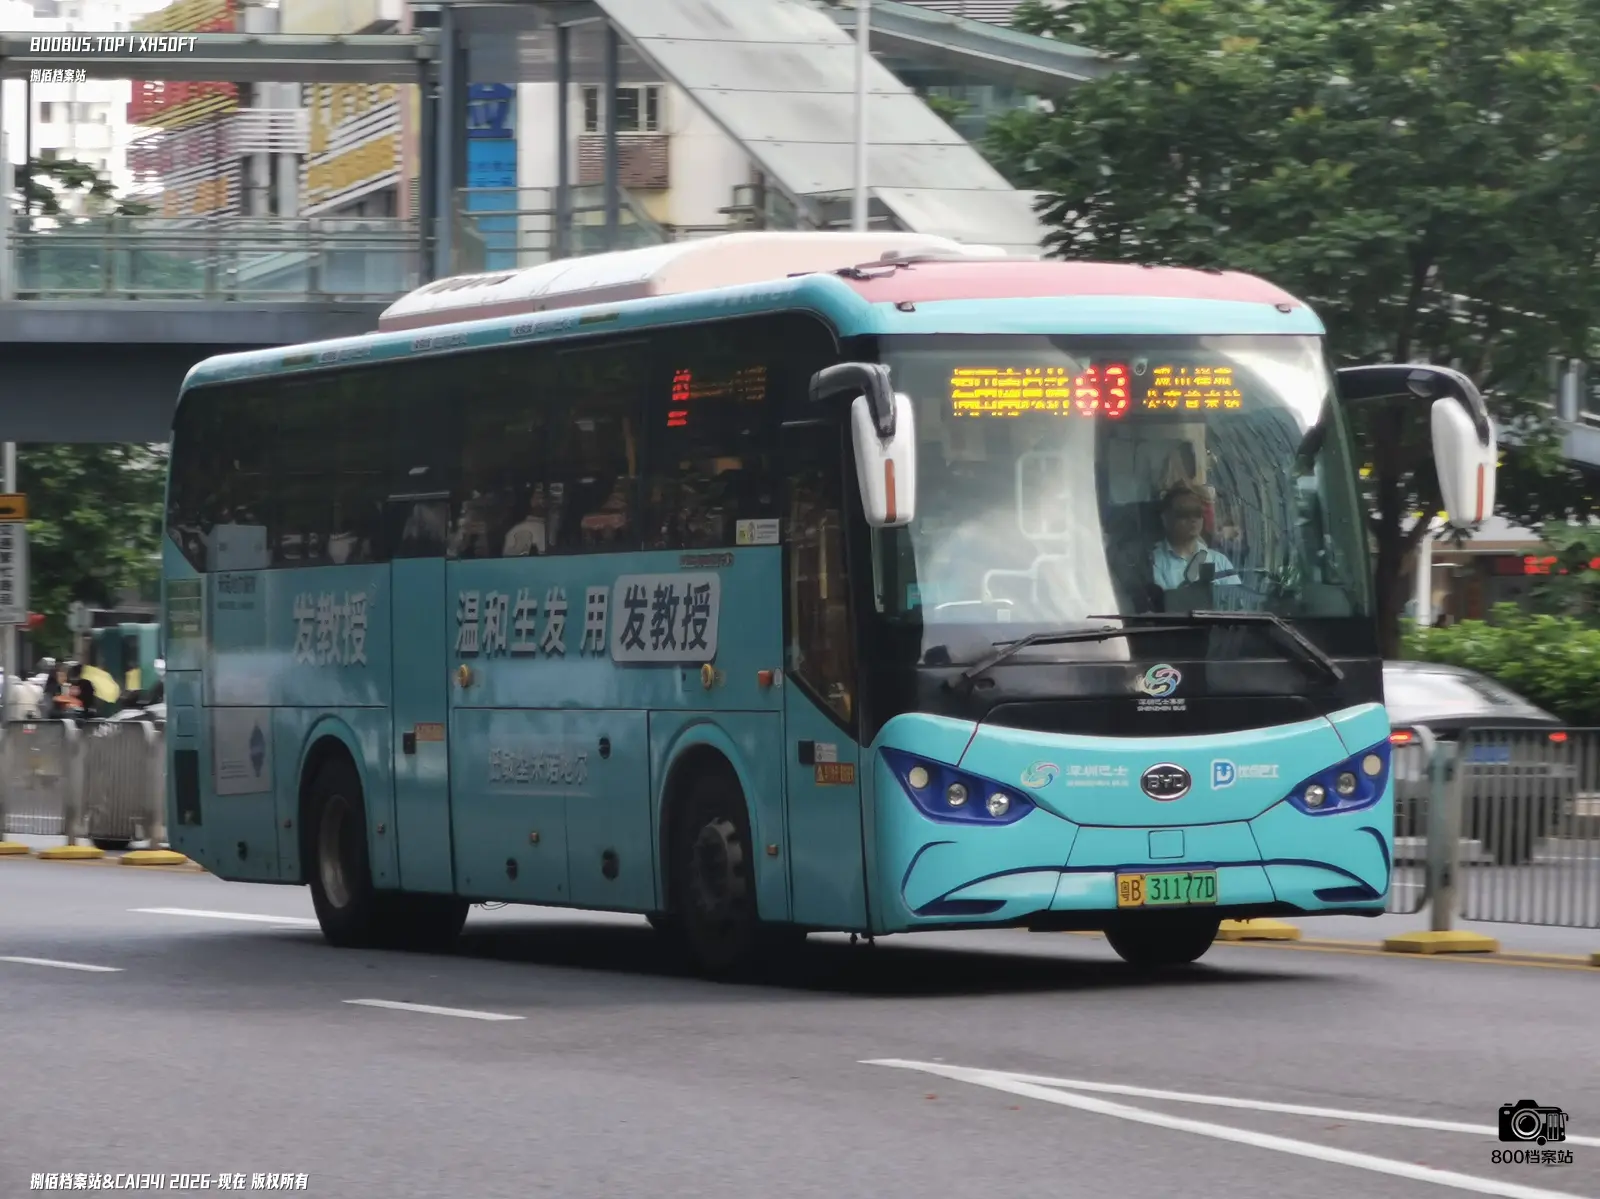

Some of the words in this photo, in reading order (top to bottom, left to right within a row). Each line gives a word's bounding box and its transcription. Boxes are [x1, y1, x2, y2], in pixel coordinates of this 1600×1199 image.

[1073, 366, 1129, 418] 63
[292, 591, 368, 667] 发教授
[456, 586, 568, 659] 温和生发
[580, 585, 609, 658] 用
[619, 581, 712, 651] 发教授
[1147, 774, 1184, 788] BYD
[1151, 876, 1215, 900] 31177D
